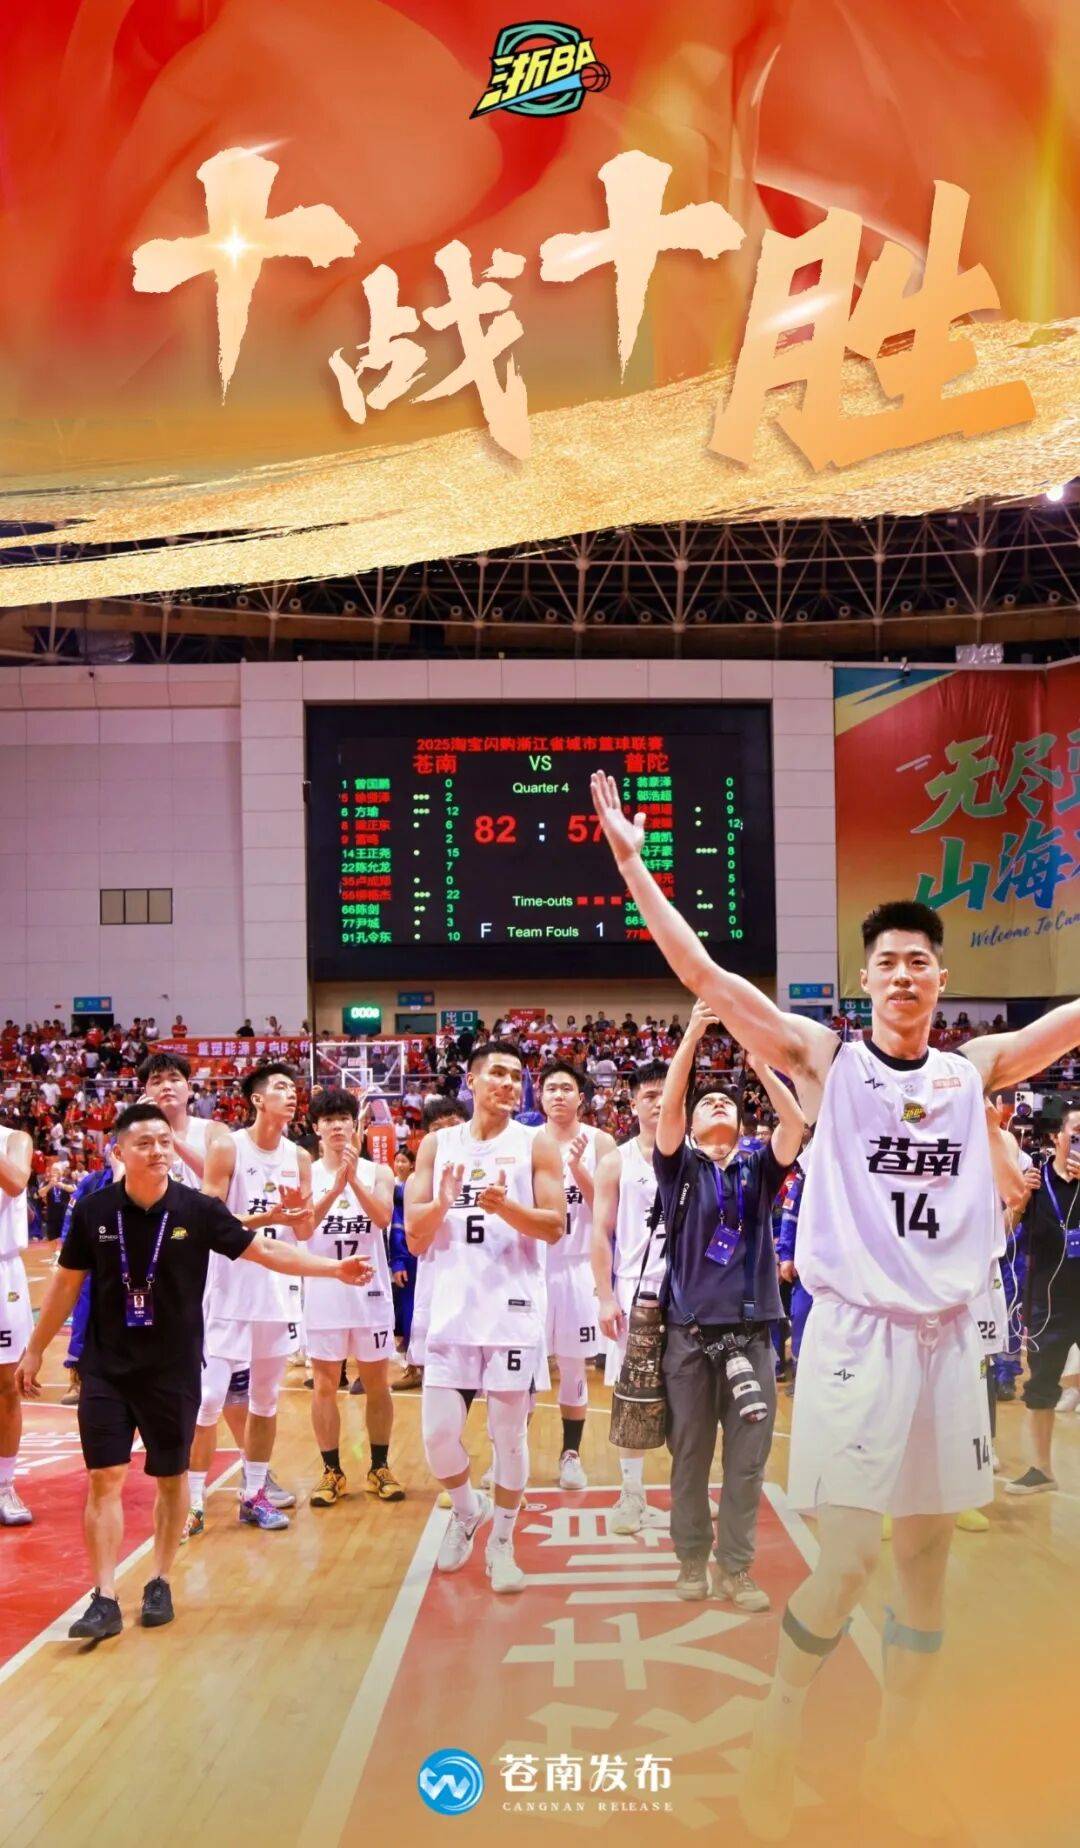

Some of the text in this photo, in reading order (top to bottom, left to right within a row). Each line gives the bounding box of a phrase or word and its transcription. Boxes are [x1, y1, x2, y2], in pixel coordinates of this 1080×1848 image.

[413, 753, 457, 774] 苍南
[529, 755, 552, 772] VS
[625, 753, 670, 774] 普陀
[445, 778, 453, 788] 0
[623, 777, 631, 787] 2
[726, 777, 734, 787] 0
[512, 782, 570, 794] Quarter 4
[445, 792, 453, 802] 2
[726, 791, 734, 801] 0
[446, 806, 460, 816] 12
[726, 804, 735, 815] 9
[445, 820, 453, 830] 6
[728, 818, 741, 828] 12
[474, 815, 517, 843] 82
[567, 815, 604, 843] 57
[445, 833, 453, 844] 2
[727, 832, 735, 842] 0
[447, 847, 460, 858] 15
[446, 861, 454, 871] 7
[727, 859, 736, 869] 0
[446, 875, 454, 886] 0
[728, 873, 736, 883] 5
[446, 889, 460, 900] 22
[728, 887, 736, 897] 4
[512, 895, 574, 907] Time-outs
[446, 903, 454, 914] 3
[446, 917, 454, 928] 3
[728, 915, 737, 925] 0
[481, 922, 493, 938] F
[507, 926, 580, 938] Team Fouls
[595, 922, 604, 937] 1
[730, 929, 744, 939] 10
[970, 925, 1031, 948] Welcome
[1035, 916, 1053, 935] To
[447, 931, 461, 942] 10
[867, 1136, 962, 1177] 苍南
[891, 1191, 940, 1240] 14
[322, 1215, 372, 1235] 苍南
[466, 1214, 485, 1244] 6
[334, 1240, 359, 1260] 17
[373, 1331, 388, 1349] 17
[579, 1326, 596, 1343] 91
[507, 1350, 522, 1371] 6
[973, 1436, 991, 1471] 14
